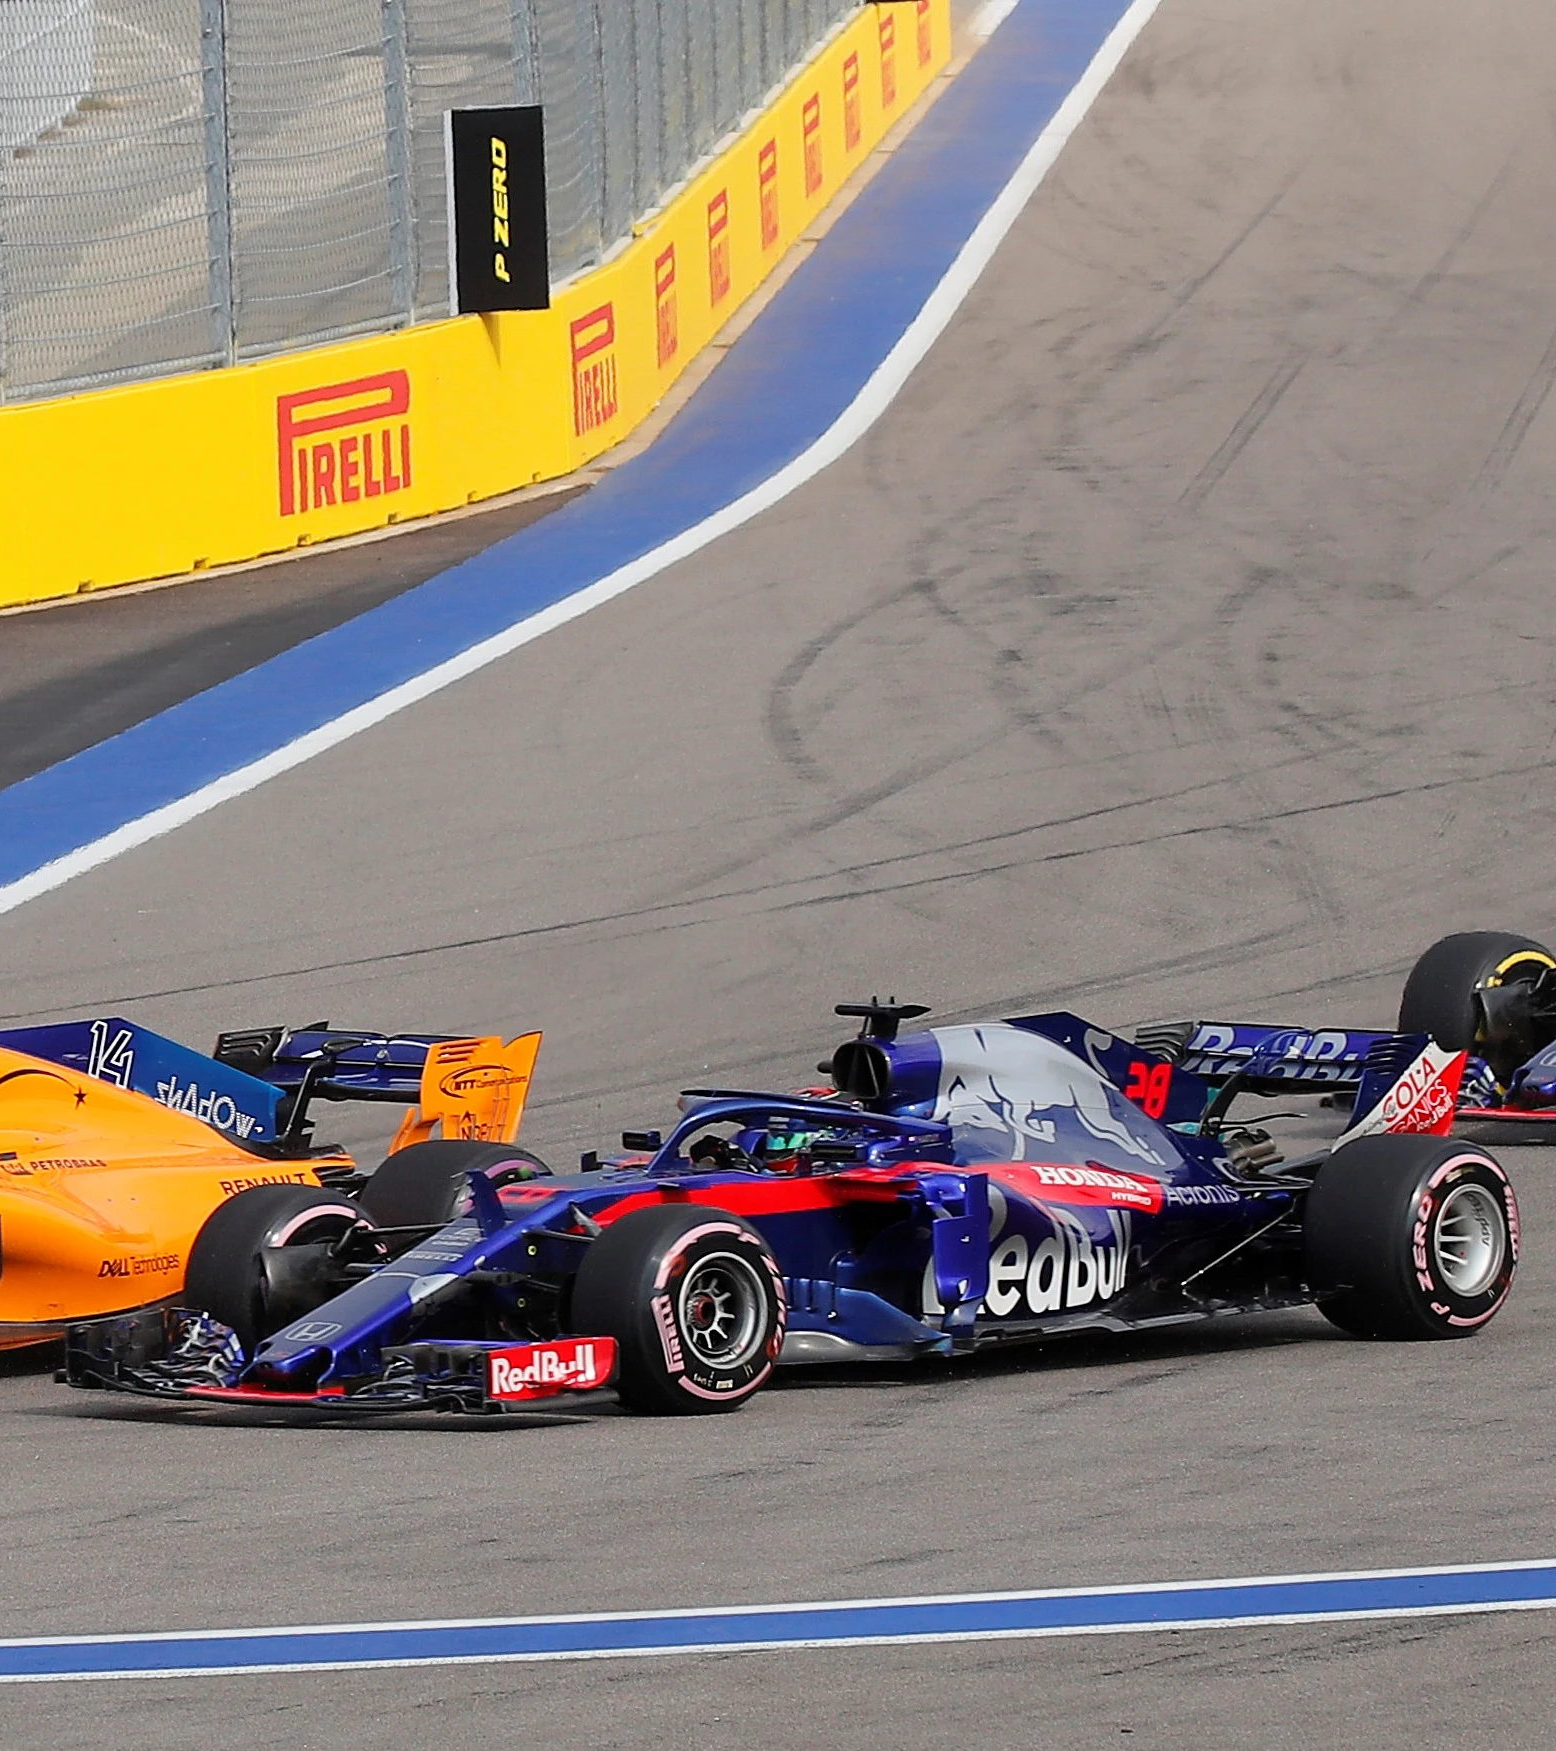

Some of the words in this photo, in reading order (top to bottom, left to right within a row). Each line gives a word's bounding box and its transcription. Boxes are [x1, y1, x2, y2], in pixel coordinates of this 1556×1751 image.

[491, 136, 510, 248] ZERO
[494, 253, 511, 283] P
[277, 370, 411, 517] PIRELLI
[88, 1020, 134, 1091] 14
[29, 1159, 107, 1171] PETROBRAS
[1030, 1165, 1148, 1193] HONDA
[219, 1173, 306, 1195] RENAULT
[1412, 1193, 1435, 1292] ZERO
[97, 1258, 131, 1278] DELL
